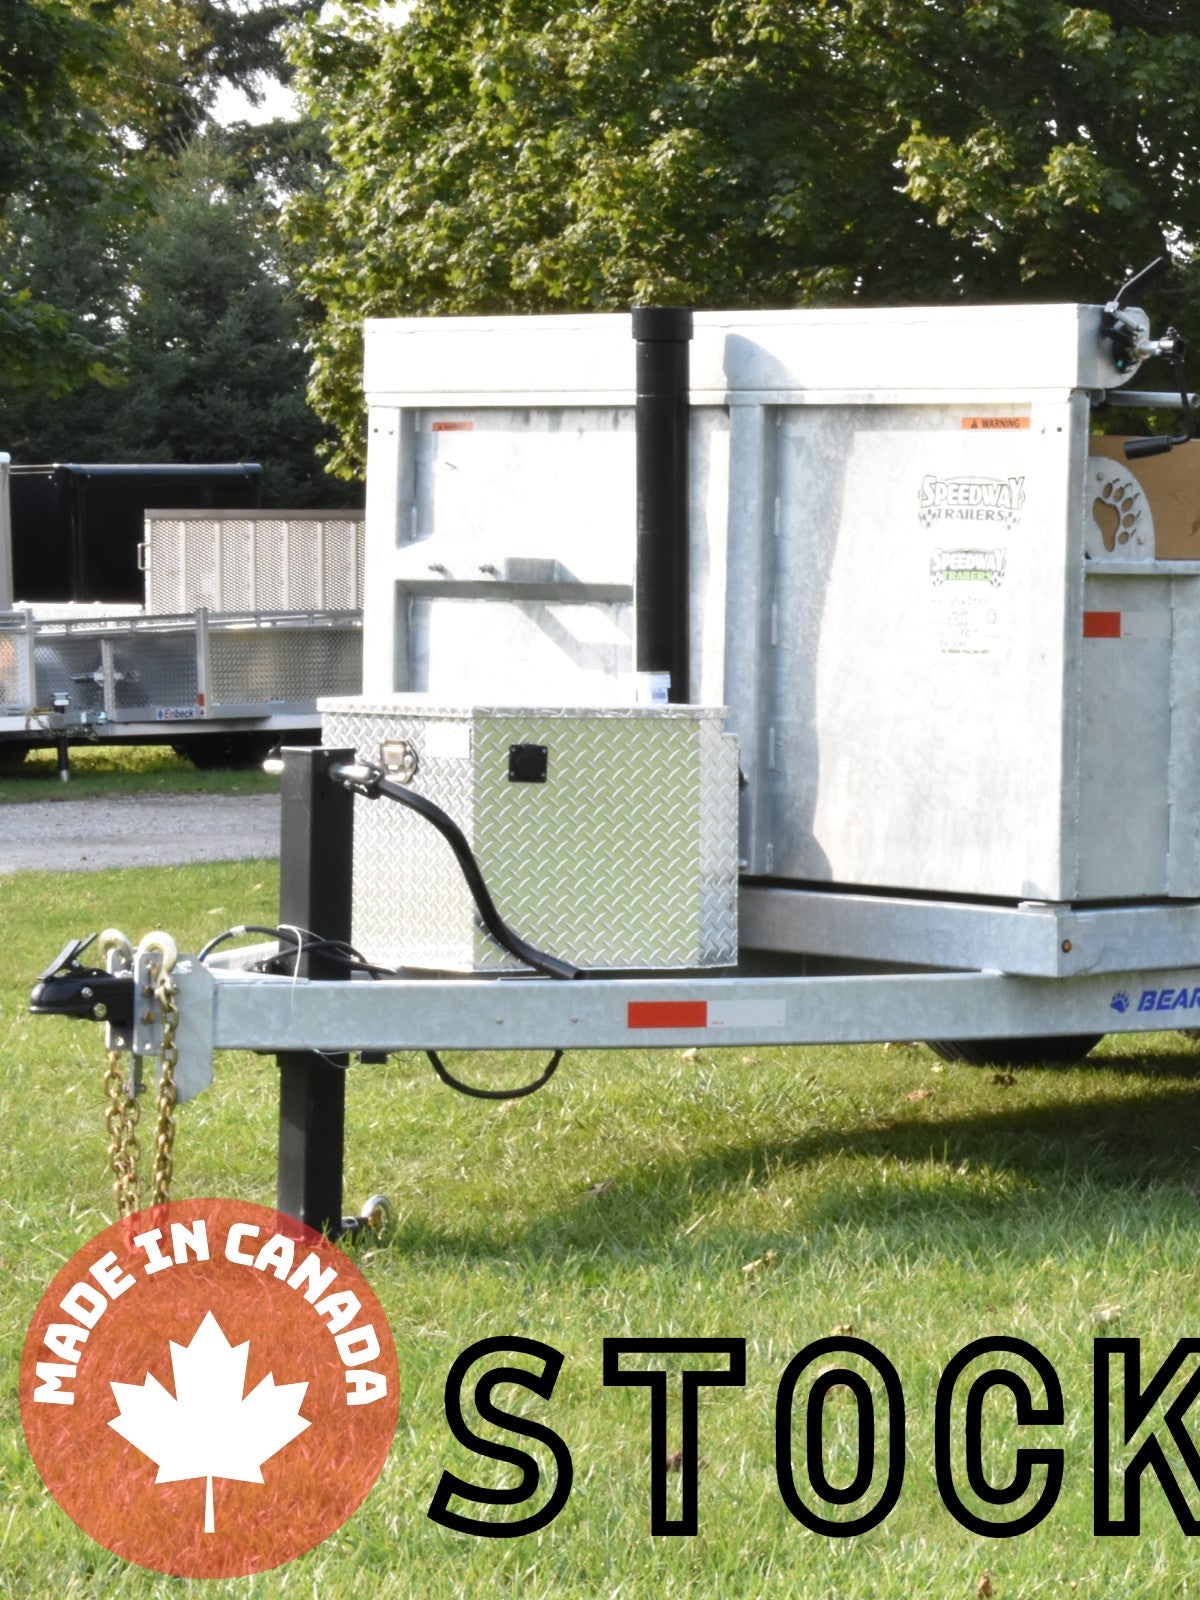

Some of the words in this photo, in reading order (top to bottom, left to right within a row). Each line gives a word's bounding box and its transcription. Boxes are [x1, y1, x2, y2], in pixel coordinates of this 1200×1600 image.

[981, 419, 1020, 429] WARNING
[920, 474, 1026, 510] SPEEDWAY
[936, 508, 1005, 522] TRAILERS
[931, 547, 1007, 572] SPEEDWAY
[944, 570, 992, 581] TRAILERS
[164, 709, 194, 719] Enbeck
